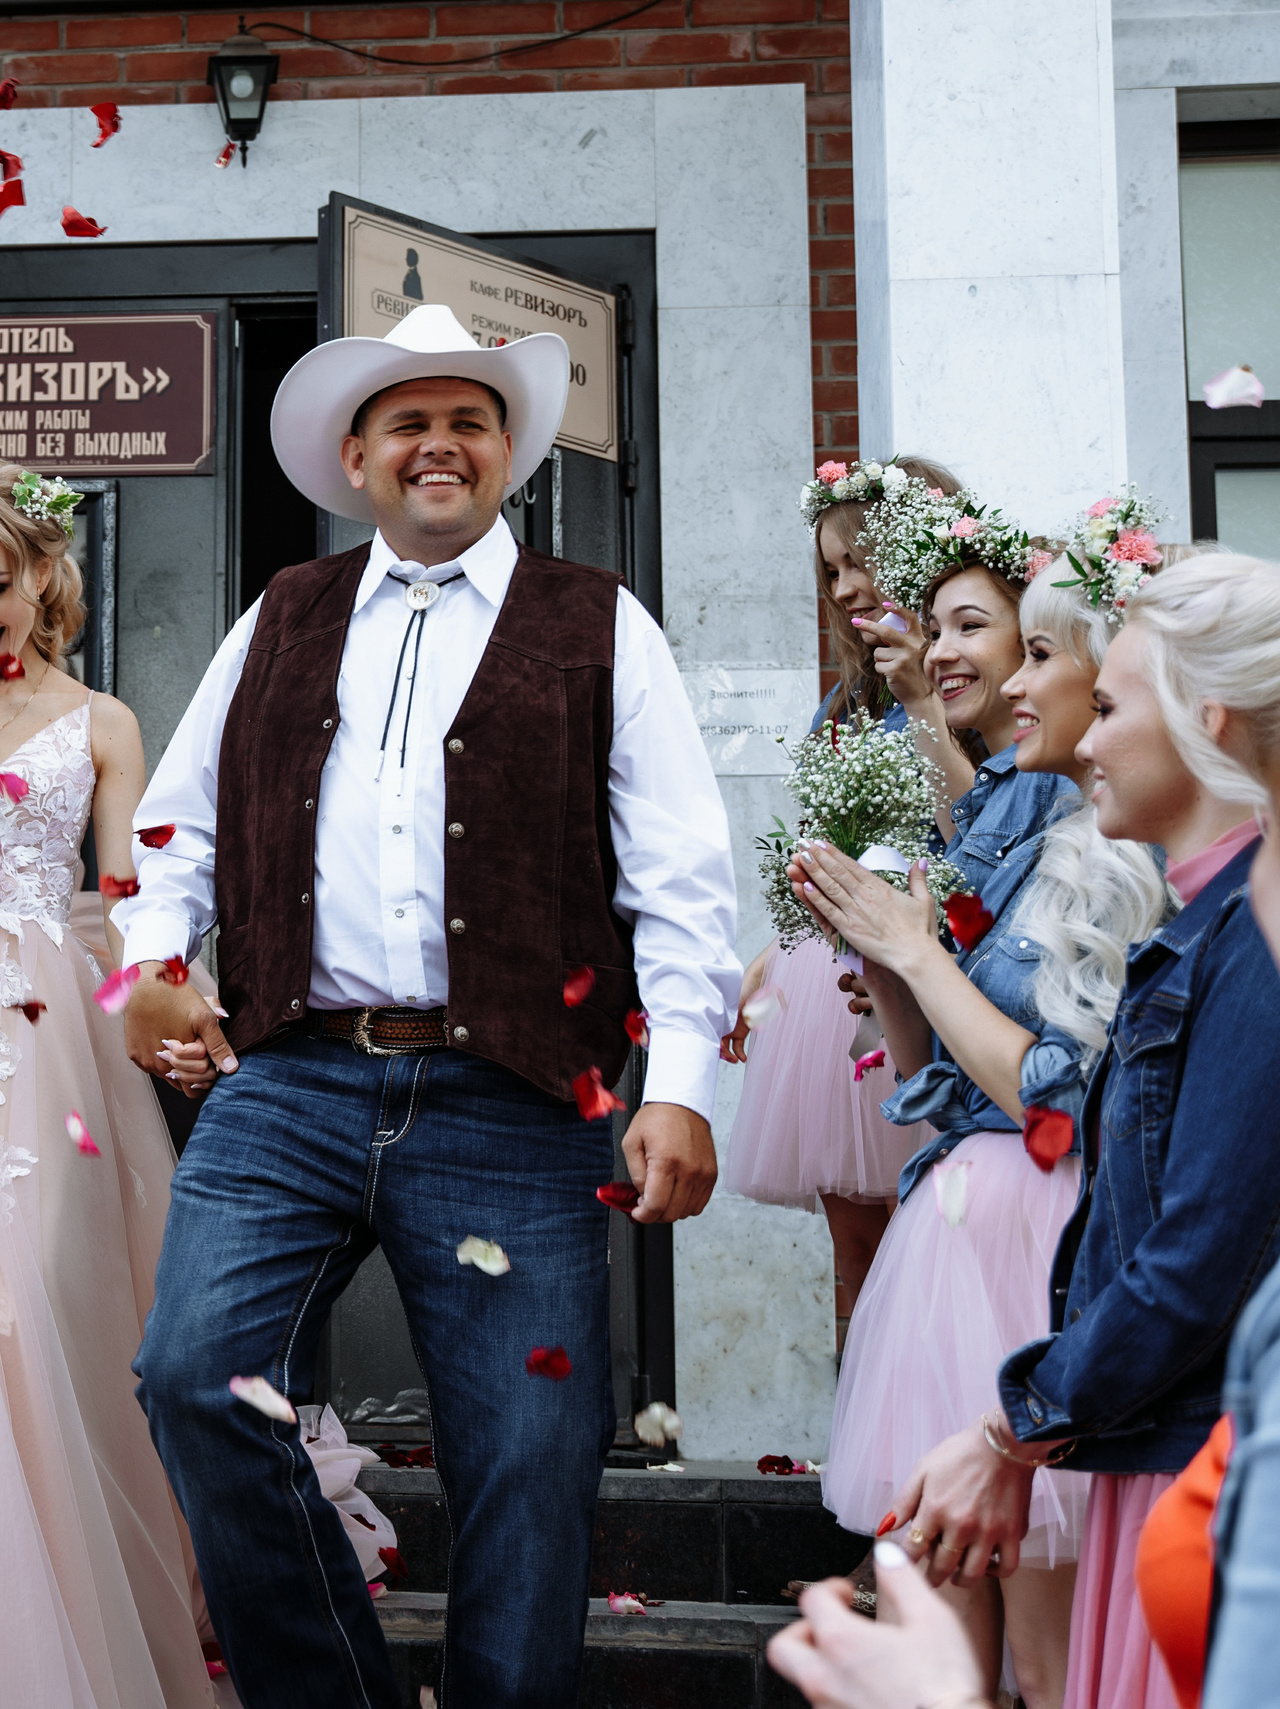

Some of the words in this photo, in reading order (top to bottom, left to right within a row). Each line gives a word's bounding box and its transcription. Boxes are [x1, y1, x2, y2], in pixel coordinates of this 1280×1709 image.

[469, 279, 502, 301] КАФЕ
[504, 286, 588, 328] РЕВИЗОРЪ
[471, 313, 512, 337] РЕЖИМ
[35, 409, 90, 430] РАБОТЫ
[35, 433, 65, 457] БЕЗ
[74, 432, 167, 459] ВЫХОДНЫХ
